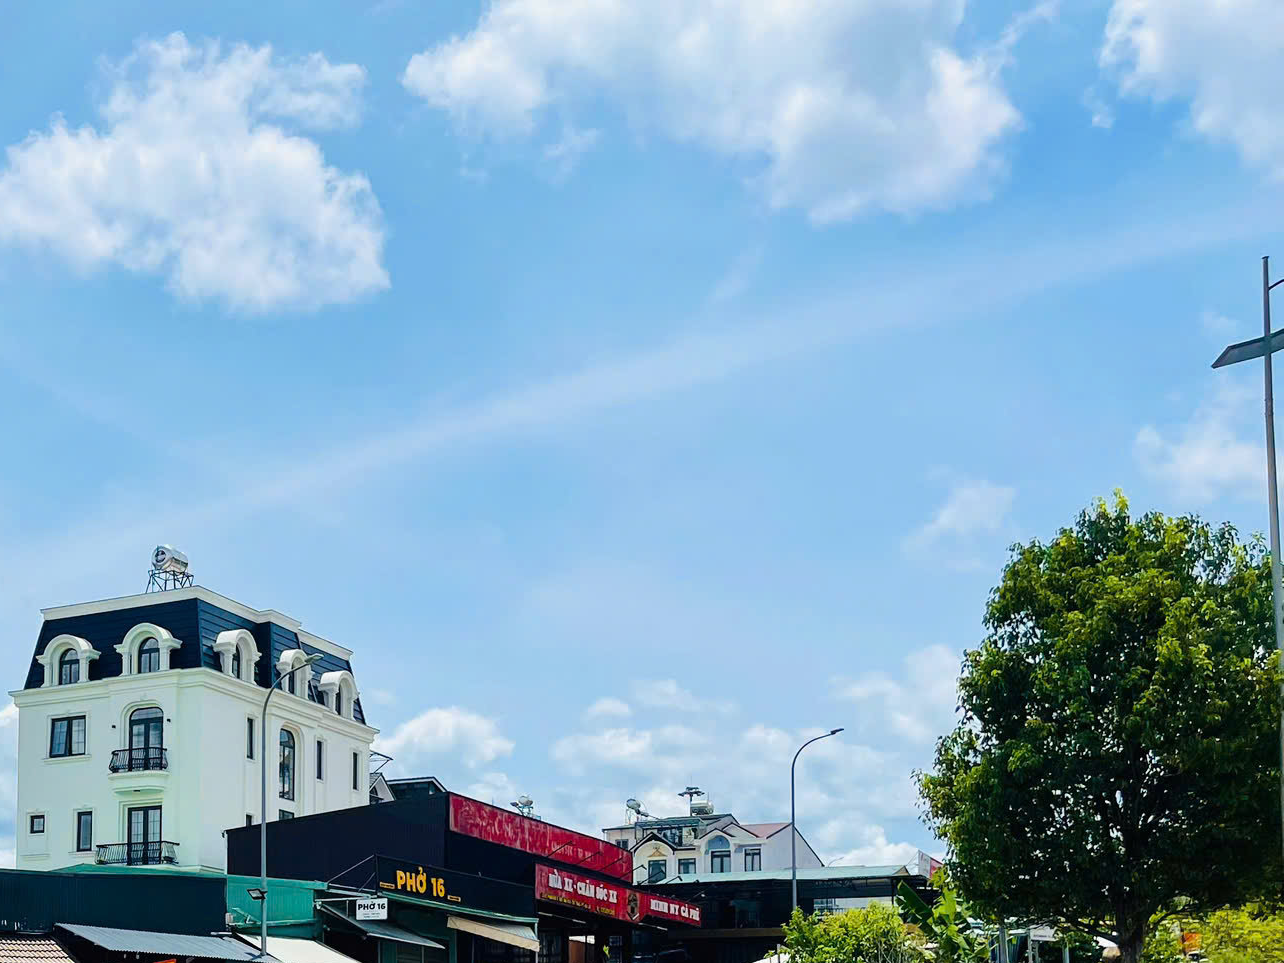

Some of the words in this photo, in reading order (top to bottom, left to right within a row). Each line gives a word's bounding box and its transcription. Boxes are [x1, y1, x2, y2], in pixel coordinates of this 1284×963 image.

[396, 866, 427, 894] PHỞ
[430, 877, 445, 897] 16
[358, 901, 376, 910] PHỞ
[377, 902, 386, 910] 16
